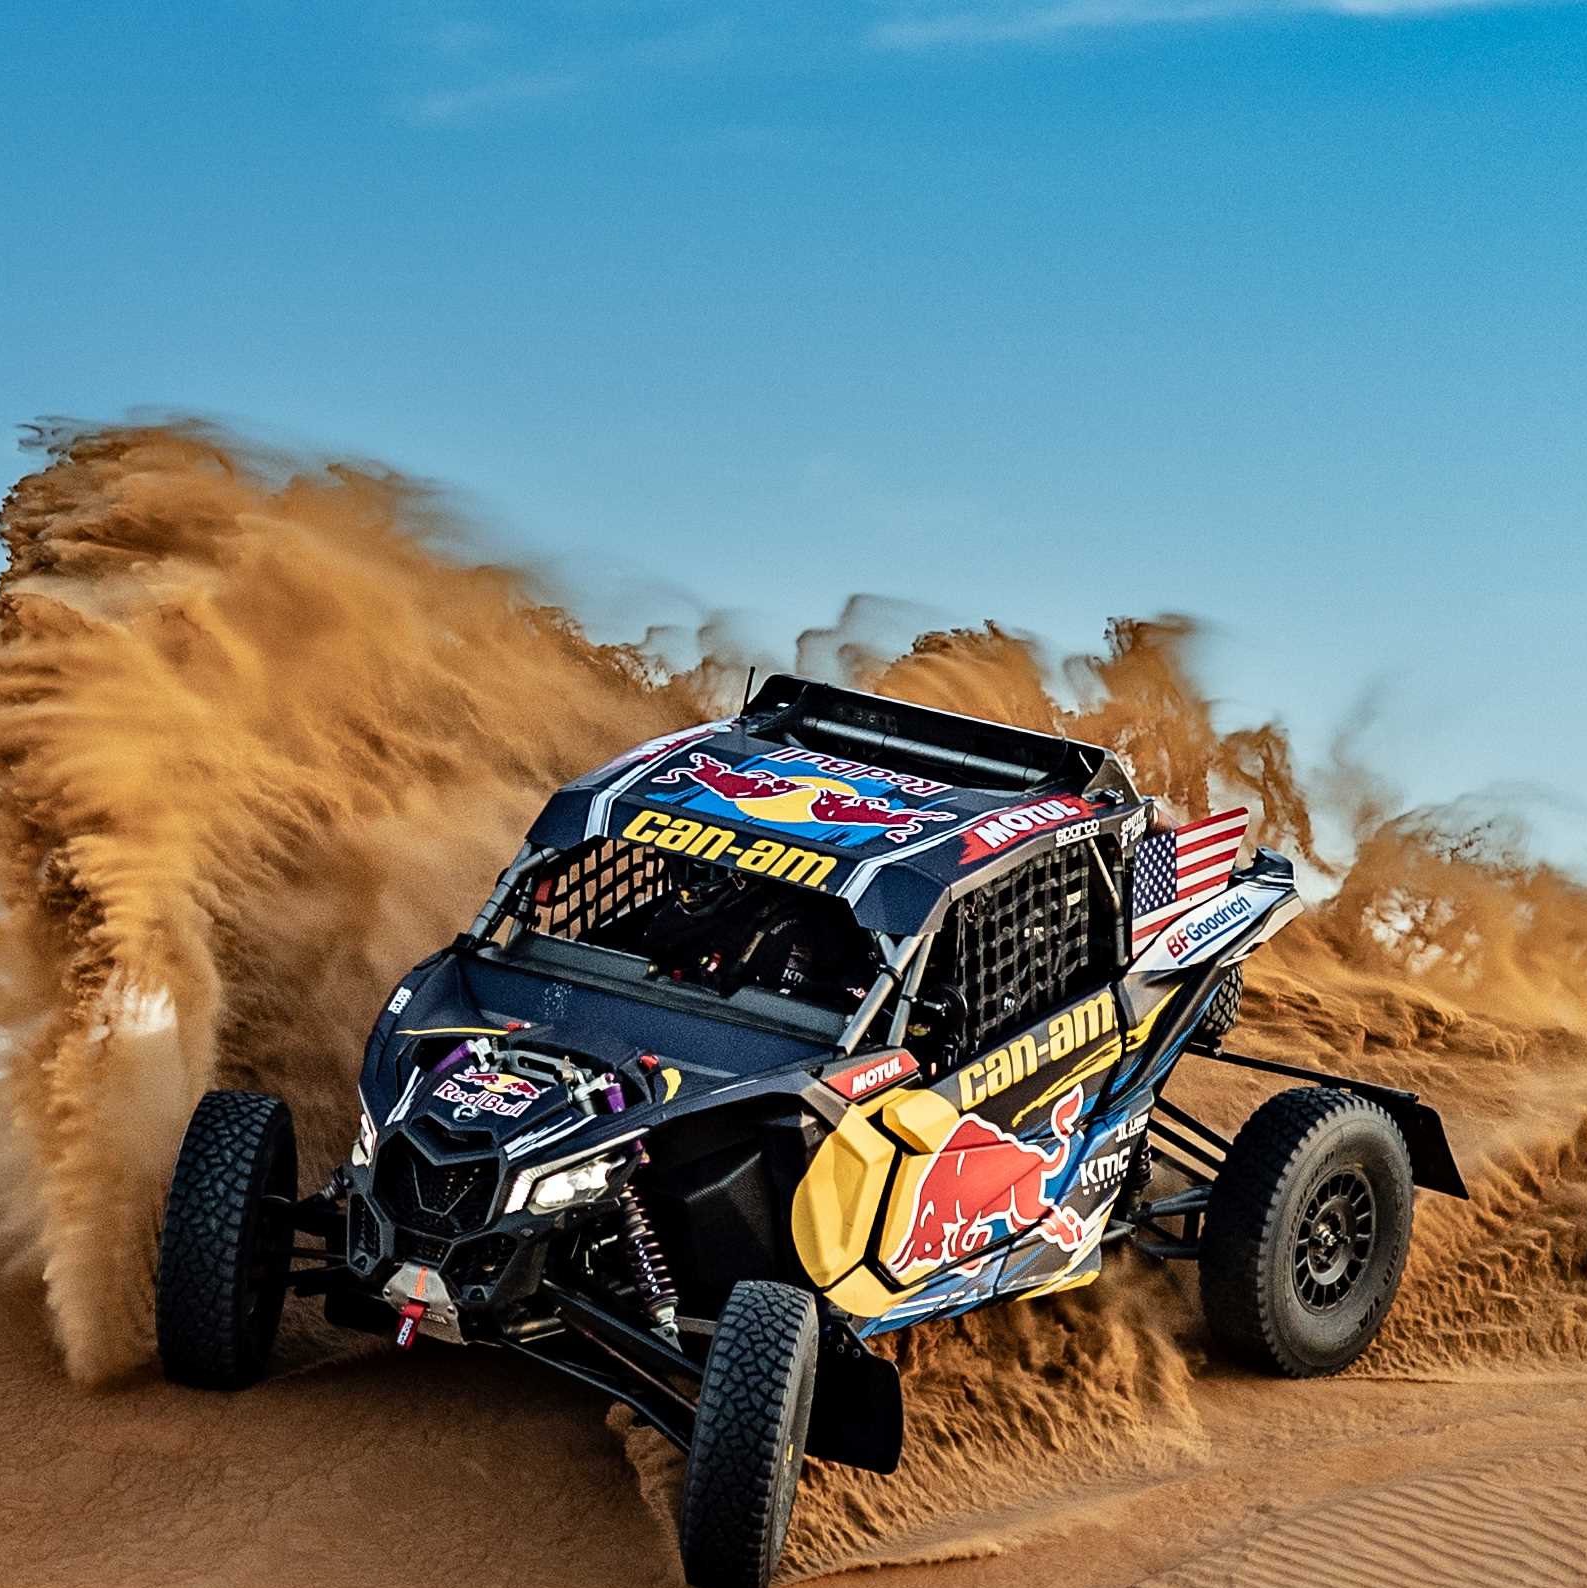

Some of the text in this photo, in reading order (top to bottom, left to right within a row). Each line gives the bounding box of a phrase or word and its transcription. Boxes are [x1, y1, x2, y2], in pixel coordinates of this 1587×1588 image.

[622, 809, 838, 888] can-am
[973, 799, 1082, 849] MOTUL
[1055, 819, 1100, 844] sparco
[1166, 892, 1252, 958] BFGoodrich
[851, 1056, 903, 1095] MOTUL
[958, 991, 1113, 1111] can-am
